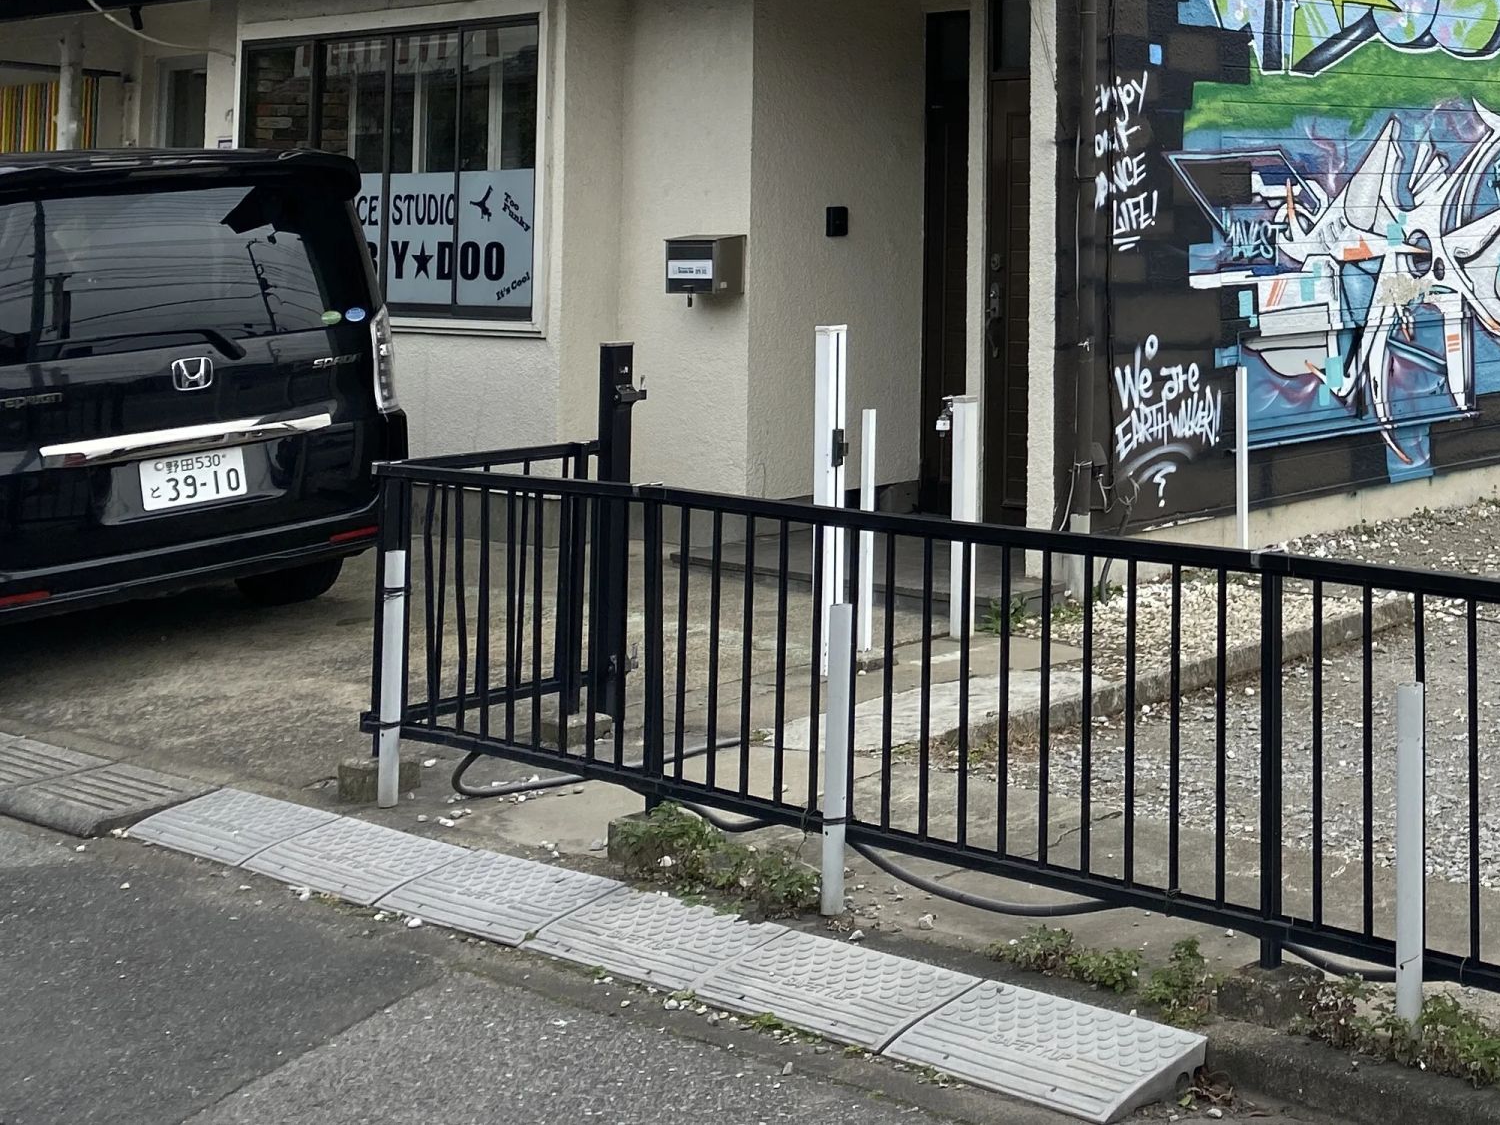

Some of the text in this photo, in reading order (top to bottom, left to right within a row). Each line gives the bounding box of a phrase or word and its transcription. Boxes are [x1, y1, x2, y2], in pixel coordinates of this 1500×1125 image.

[392, 193, 455, 225] STUDIO
[195, 453, 221, 470] 530
[151, 468, 240, 501] と 39-10
